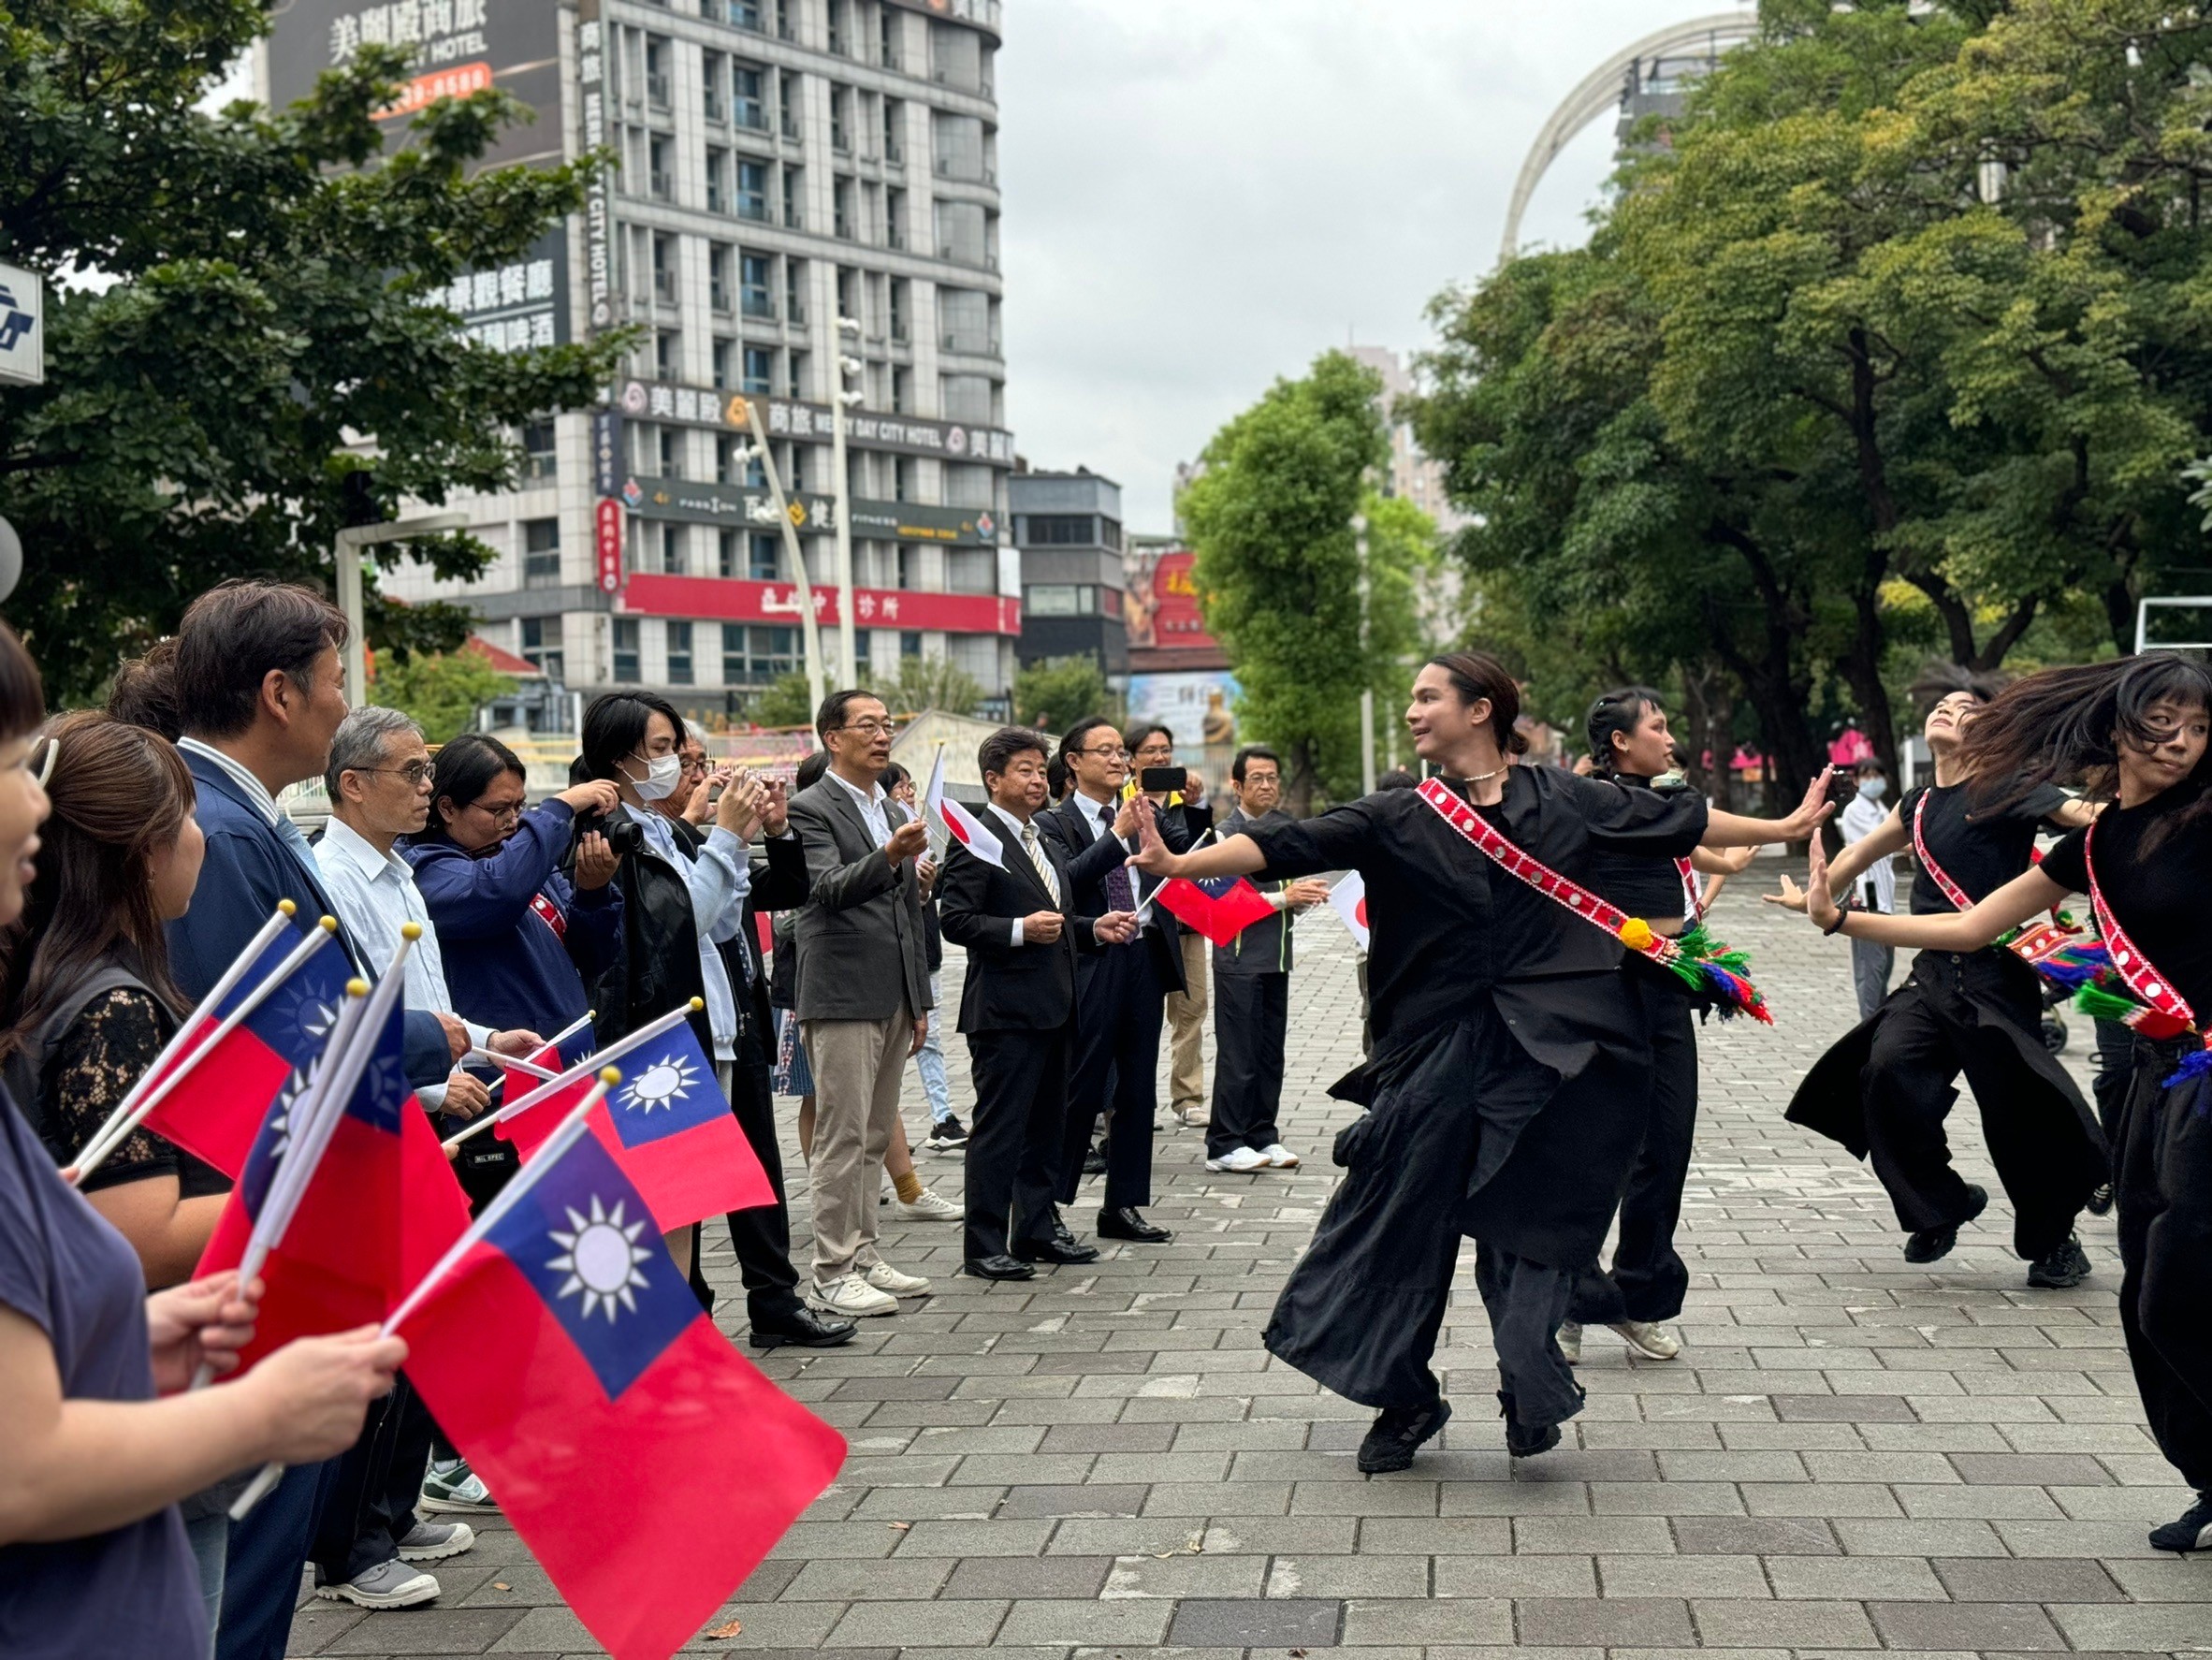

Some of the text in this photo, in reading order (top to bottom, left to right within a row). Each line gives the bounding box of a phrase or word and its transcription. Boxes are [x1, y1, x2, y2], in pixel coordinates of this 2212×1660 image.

[430, 30, 488, 64] HOTEL
[589, 197, 606, 240] CITY
[589, 245, 608, 305] HOTEL
[855, 417, 880, 438] DAY
[879, 421, 906, 444] CITY
[906, 424, 943, 448] HOTEL
[851, 513, 898, 527] FITNESS
